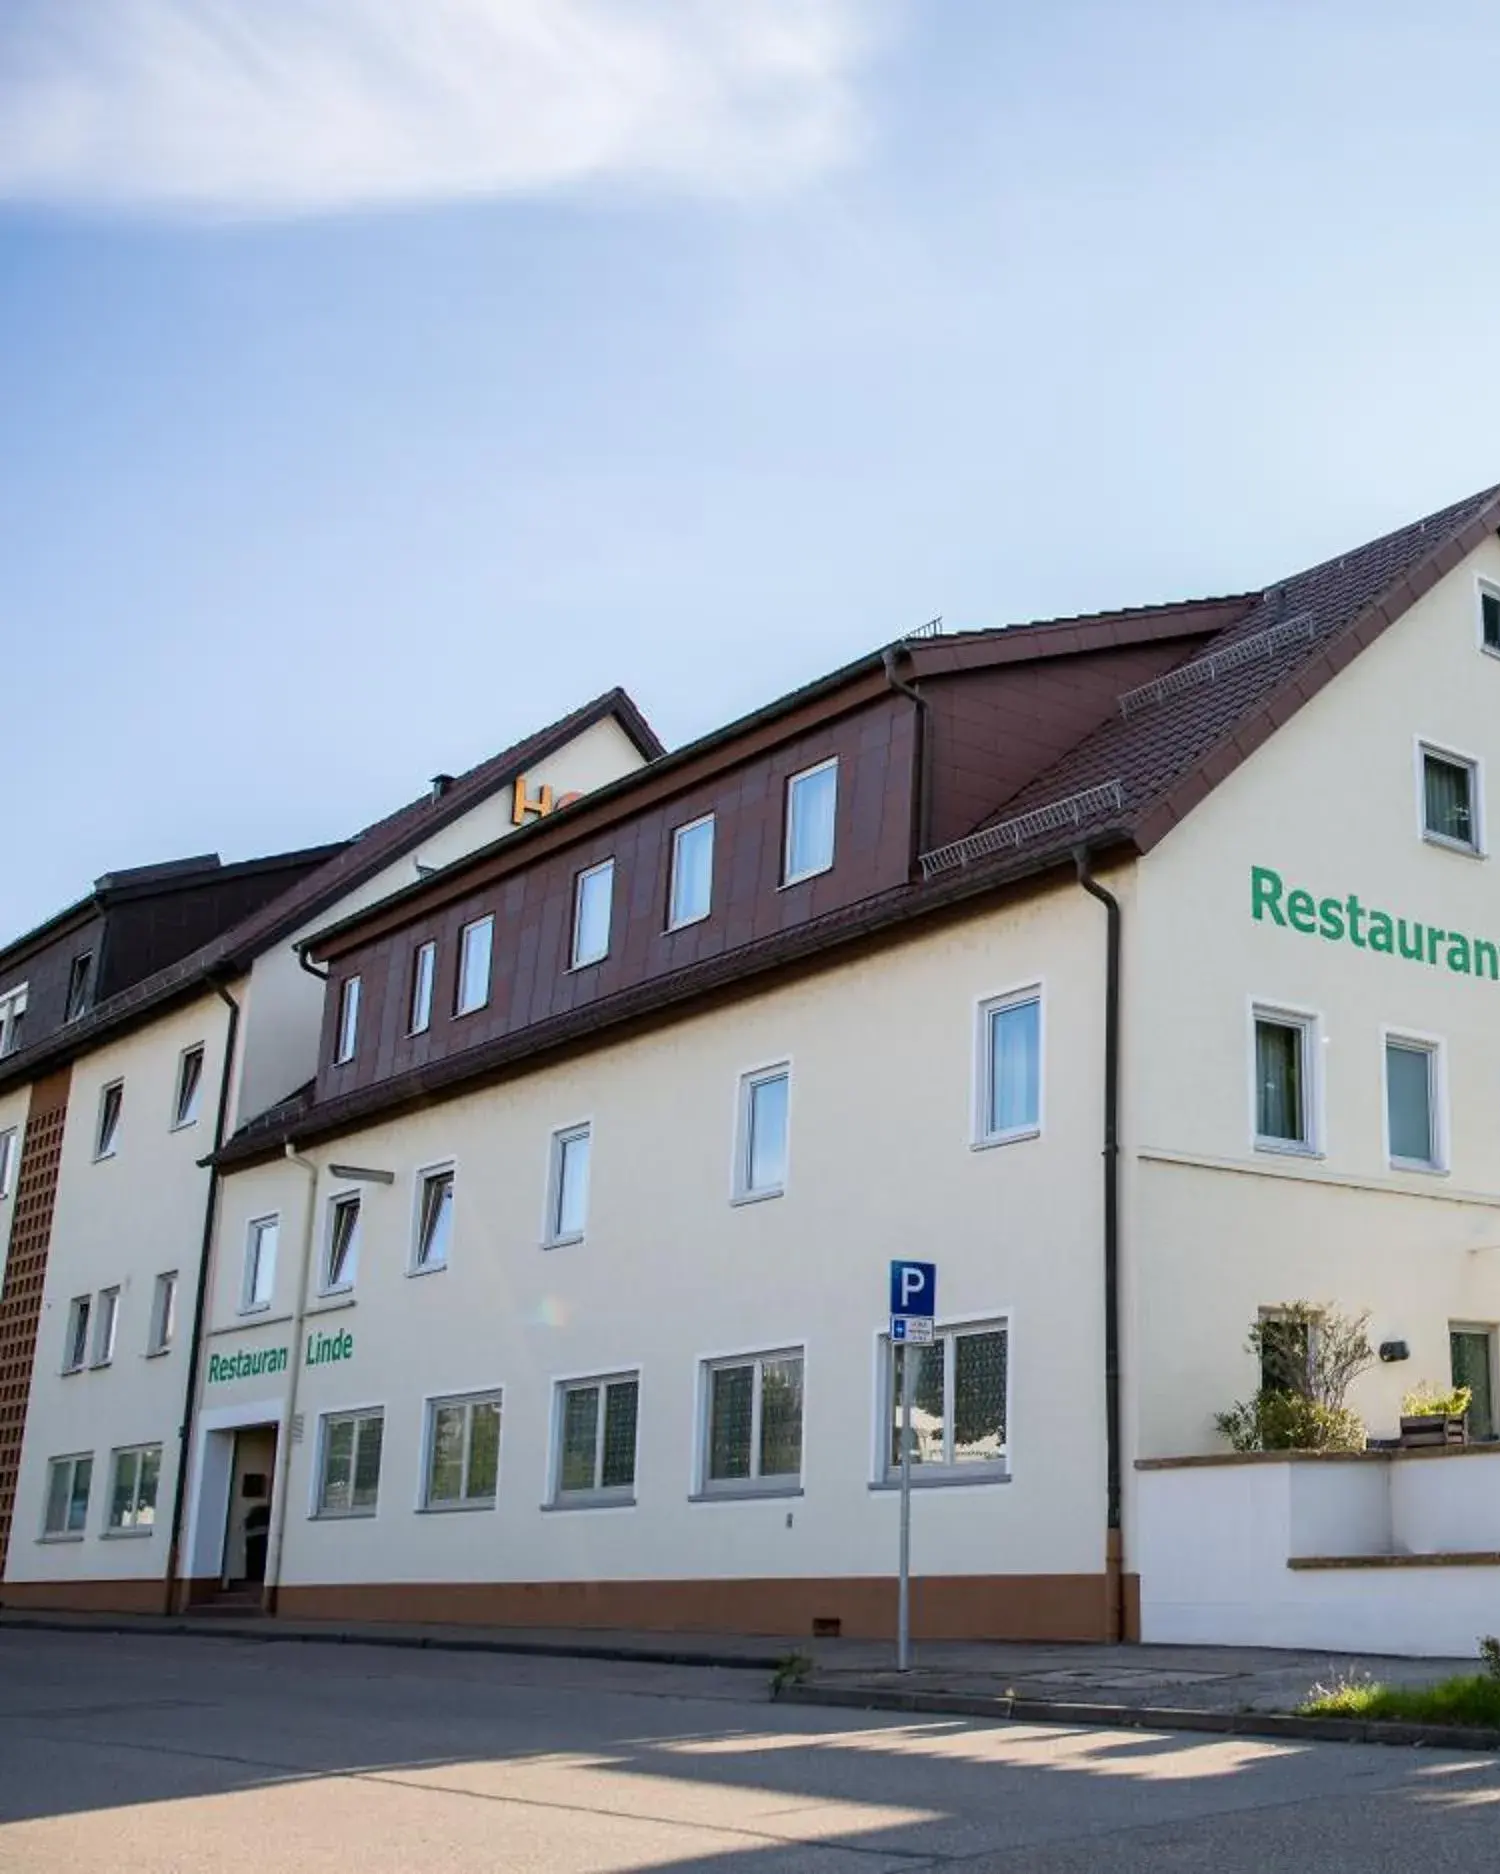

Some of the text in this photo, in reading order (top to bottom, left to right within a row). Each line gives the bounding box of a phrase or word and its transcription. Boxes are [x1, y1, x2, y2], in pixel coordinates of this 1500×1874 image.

[901, 1267, 925, 1307] P
[208, 1328, 353, 1383] Restauran Linde
